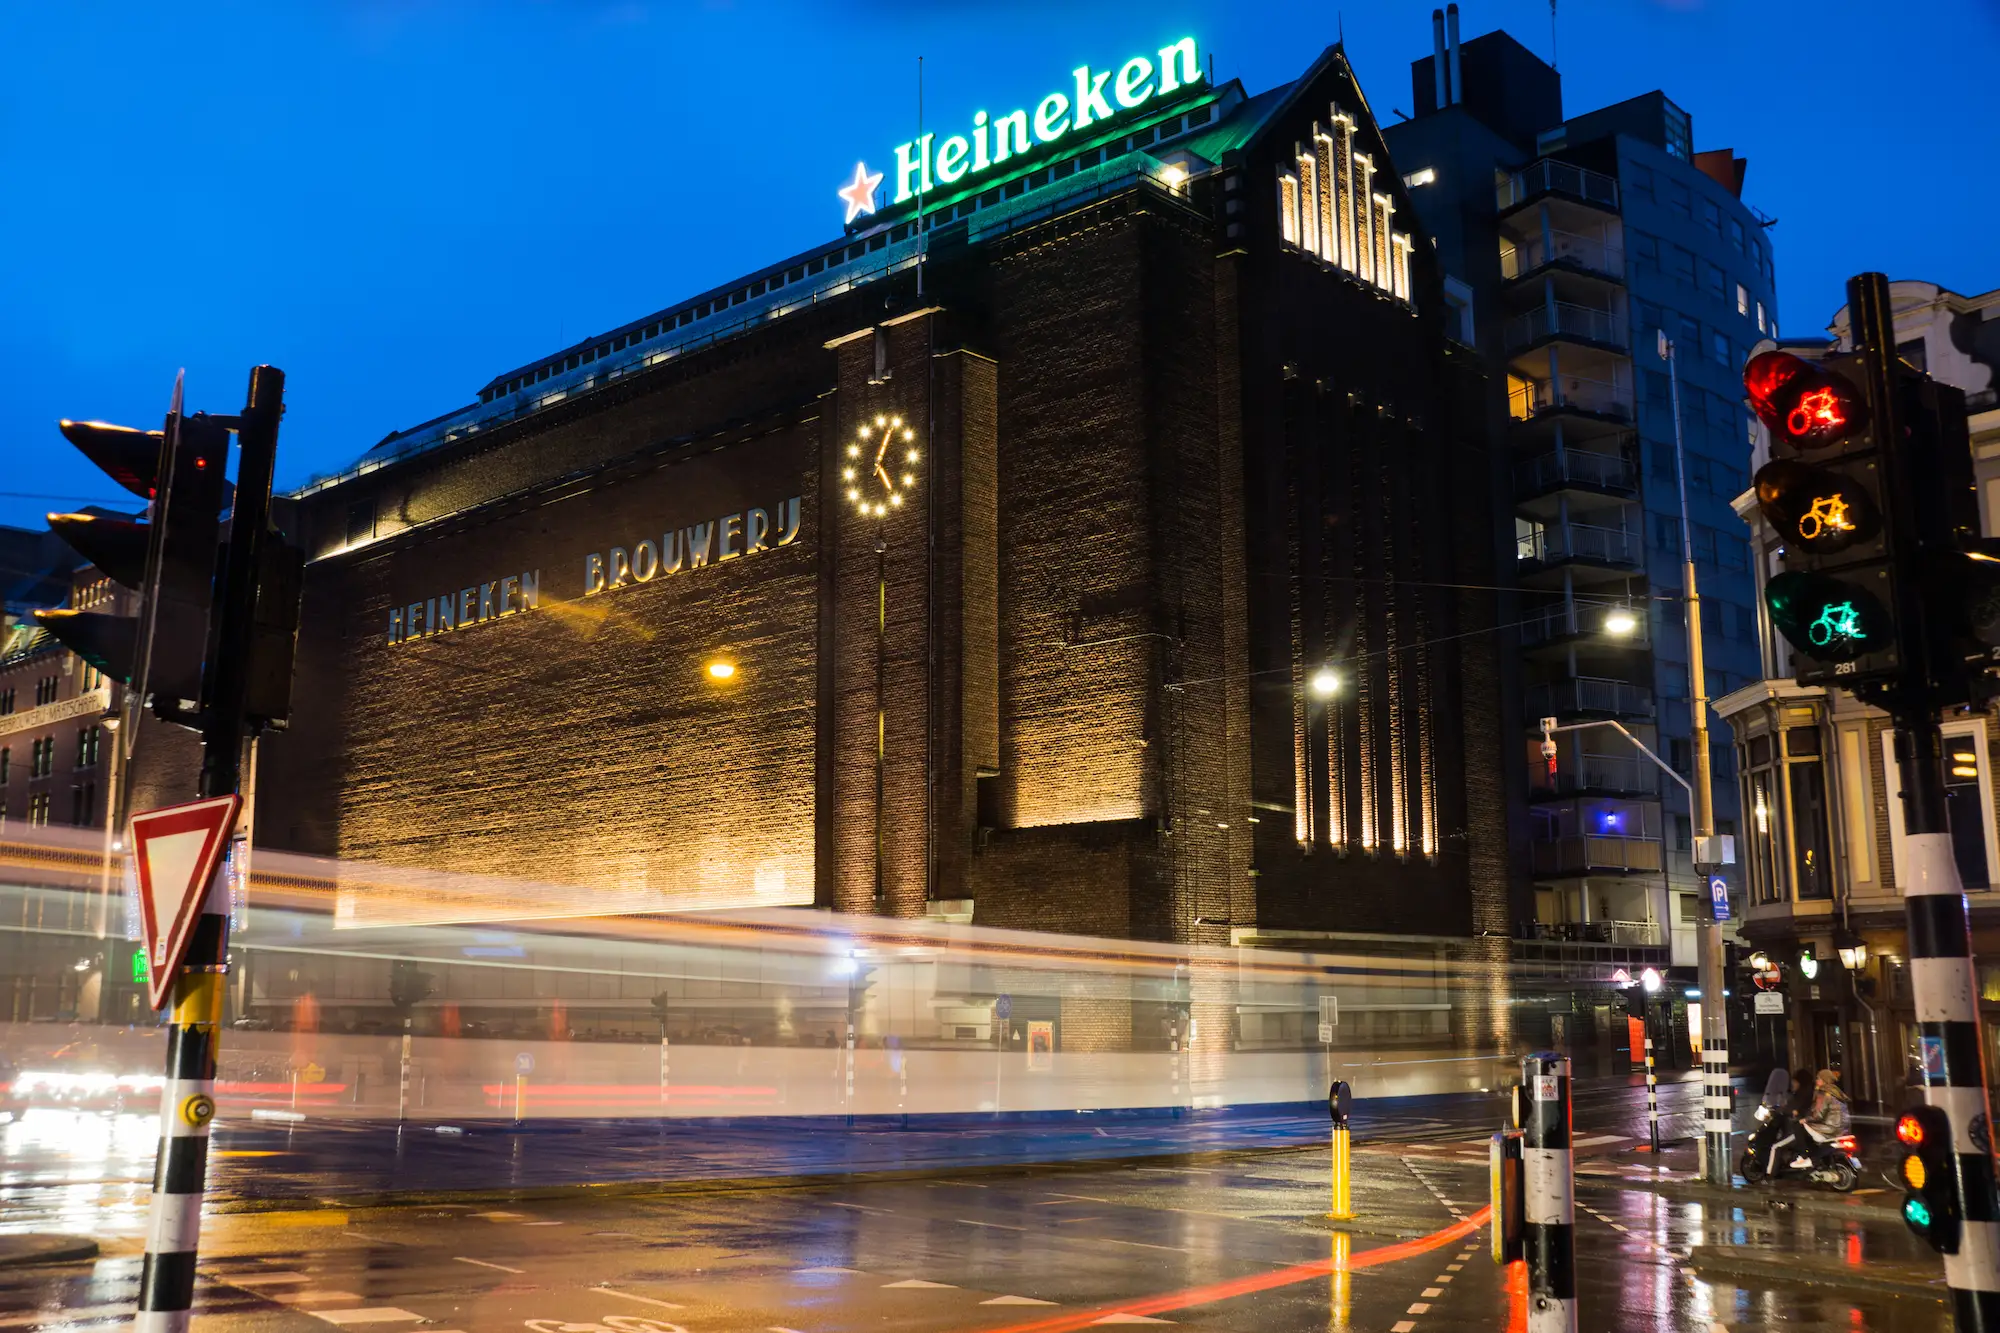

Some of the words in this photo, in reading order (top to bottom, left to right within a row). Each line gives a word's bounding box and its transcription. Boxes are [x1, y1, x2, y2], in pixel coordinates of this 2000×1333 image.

[893, 36, 1204, 204] Heineken
[387, 569, 540, 647] HEINEKEN
[585, 496, 801, 597] BROUWERIJ
[1834, 661, 1857, 675] 281
